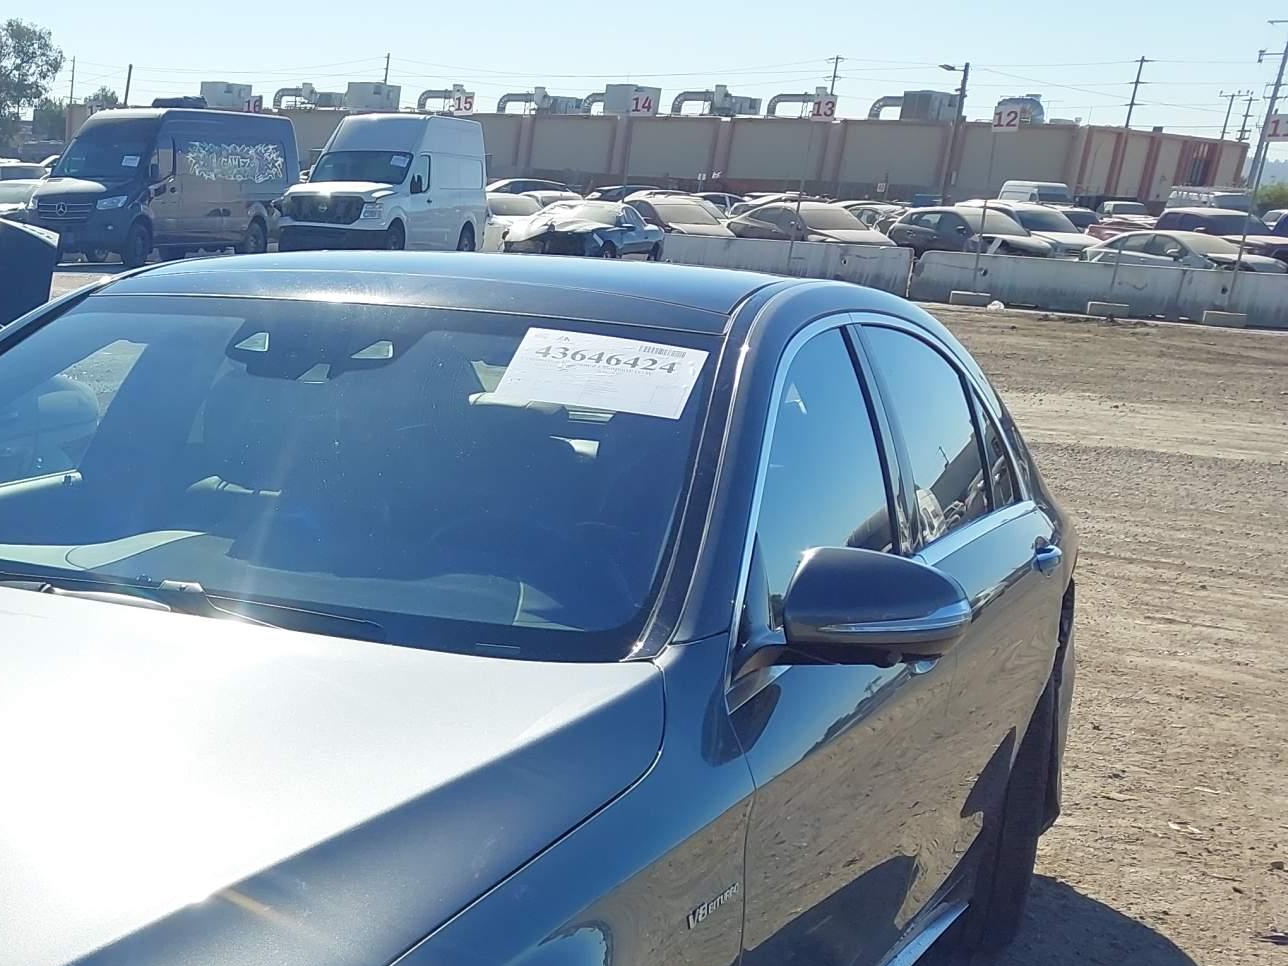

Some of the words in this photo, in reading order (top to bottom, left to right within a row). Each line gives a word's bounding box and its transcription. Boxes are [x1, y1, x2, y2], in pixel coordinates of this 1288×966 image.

[246, 99, 261, 113] 16
[455, 95, 473, 111] 15
[631, 96, 652, 112] 14
[812, 100, 835, 117] 13
[993, 110, 1018, 127] 12
[1267, 118, 1288, 138] 1
[535, 345, 678, 374] 43646424
[687, 902, 708, 929] V8
